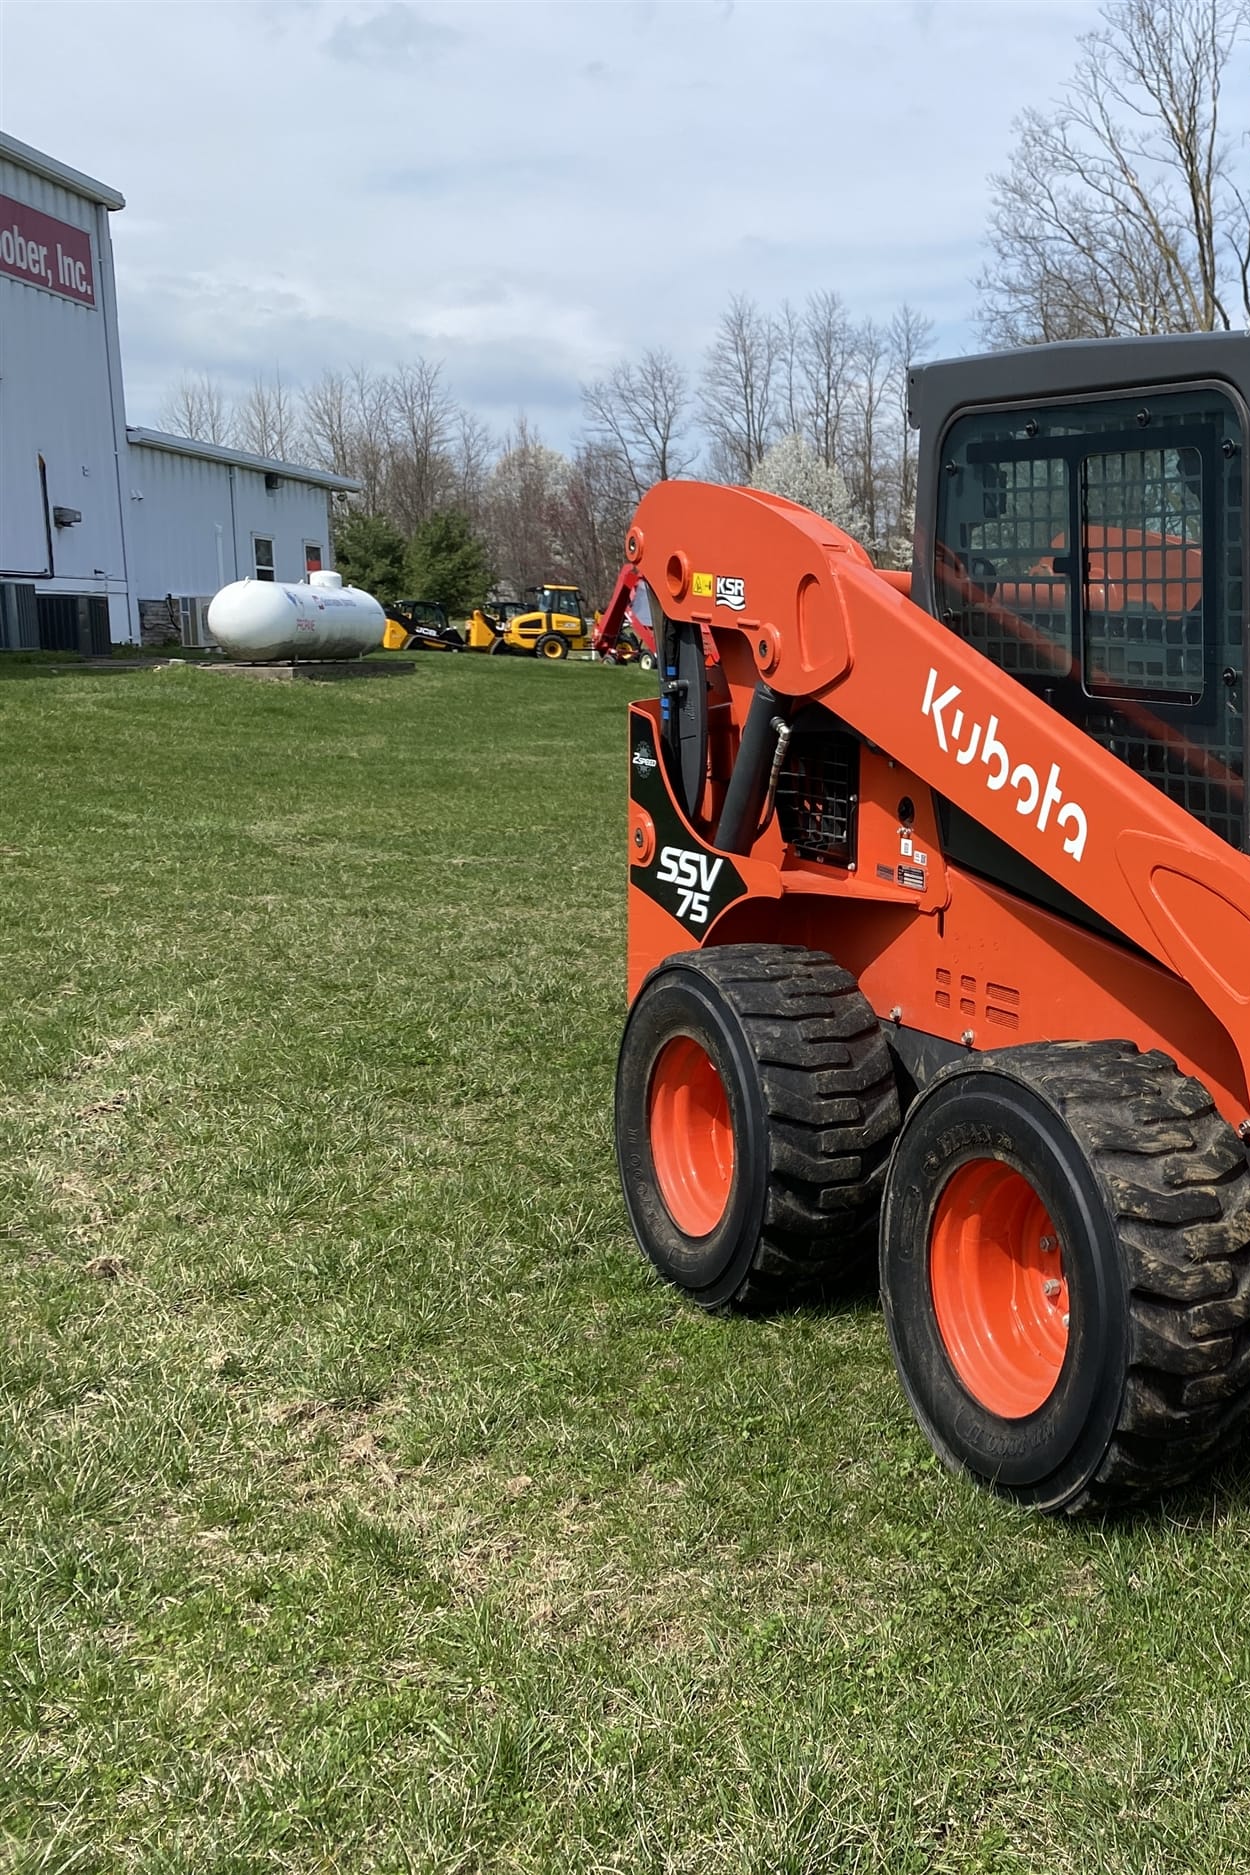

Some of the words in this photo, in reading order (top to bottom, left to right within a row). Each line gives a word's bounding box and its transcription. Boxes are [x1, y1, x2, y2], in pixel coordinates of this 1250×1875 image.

[0, 225, 52, 288] ober,
[56, 243, 92, 295] Inc.
[716, 577, 745, 596] KSR
[921, 667, 1088, 862] Kubota
[656, 846, 724, 892] SSV
[675, 888, 711, 923] 75
